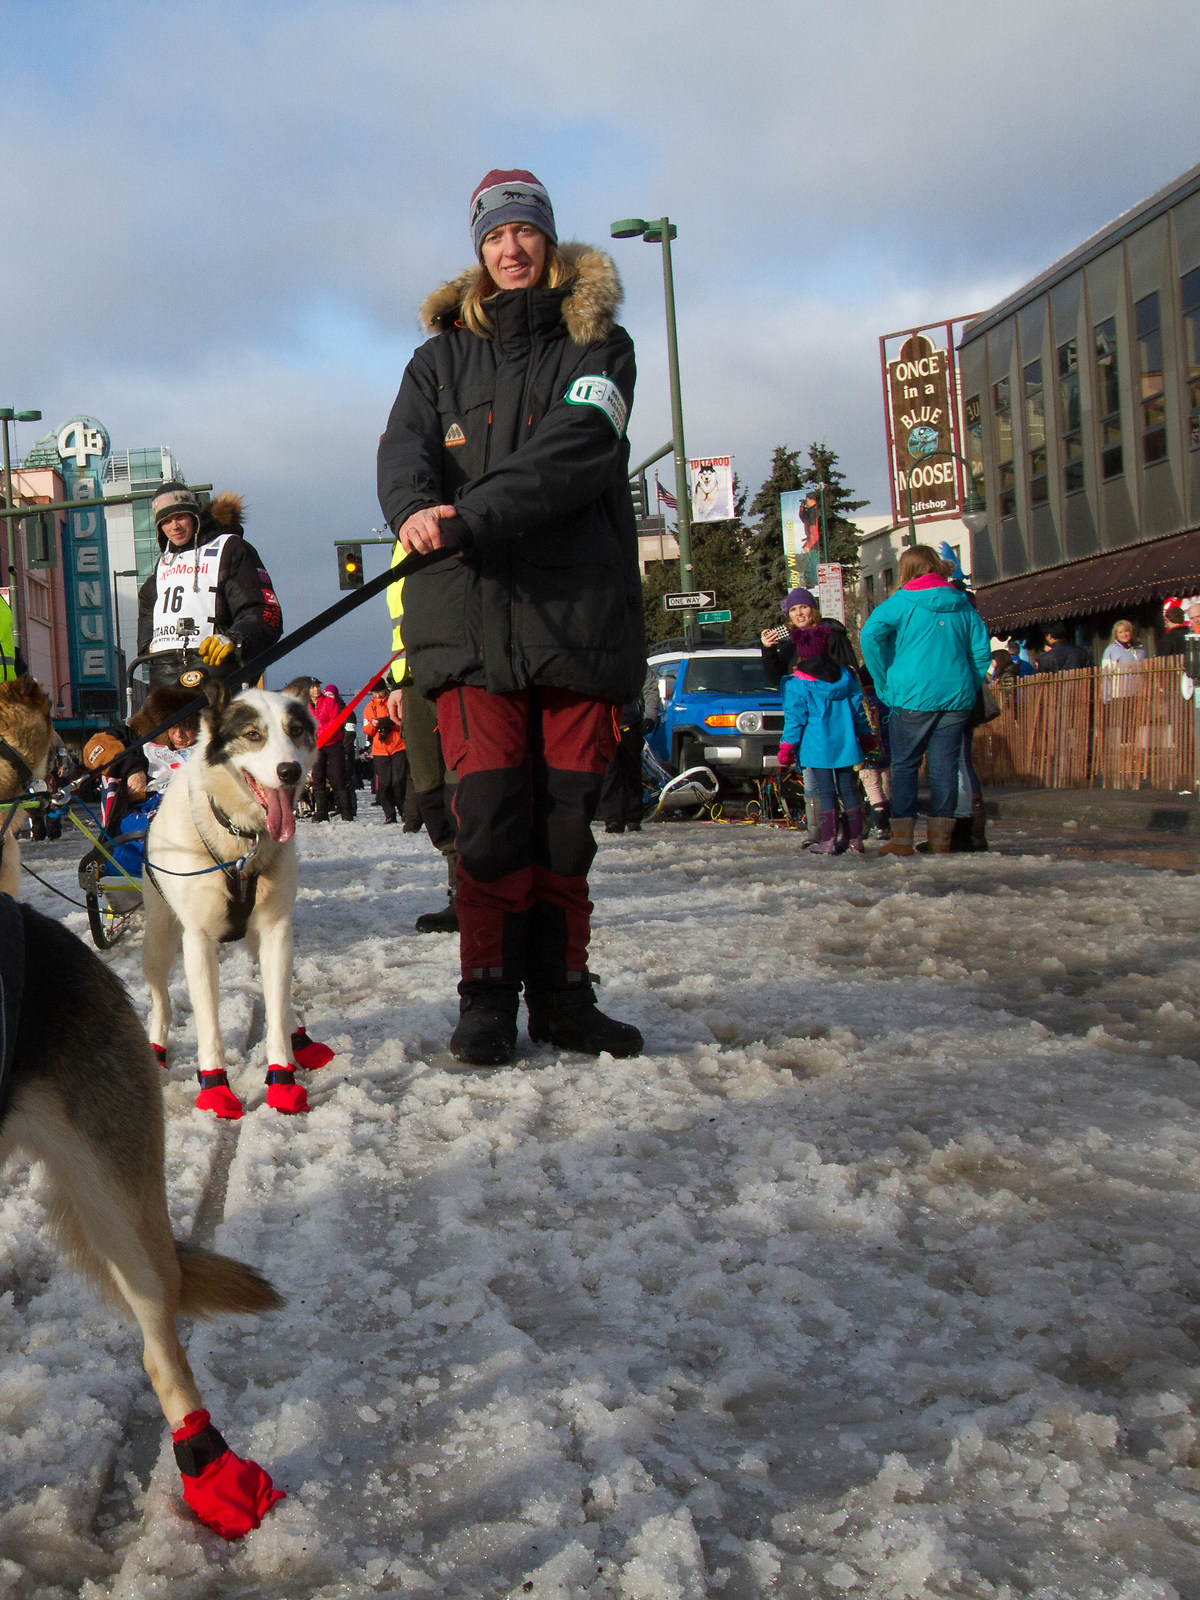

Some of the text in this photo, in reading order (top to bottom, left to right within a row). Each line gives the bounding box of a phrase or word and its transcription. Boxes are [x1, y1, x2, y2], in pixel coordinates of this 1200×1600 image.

[895, 356, 940, 381] ONCE
[903, 383, 935, 399] in a
[900, 406, 942, 430] BLUE
[898, 461, 953, 491] MOOSE
[71, 477, 107, 677] AVENUE
[790, 569, 800, 589] njoy
[162, 585, 185, 614] 16
[670, 597, 685, 605] ONE
